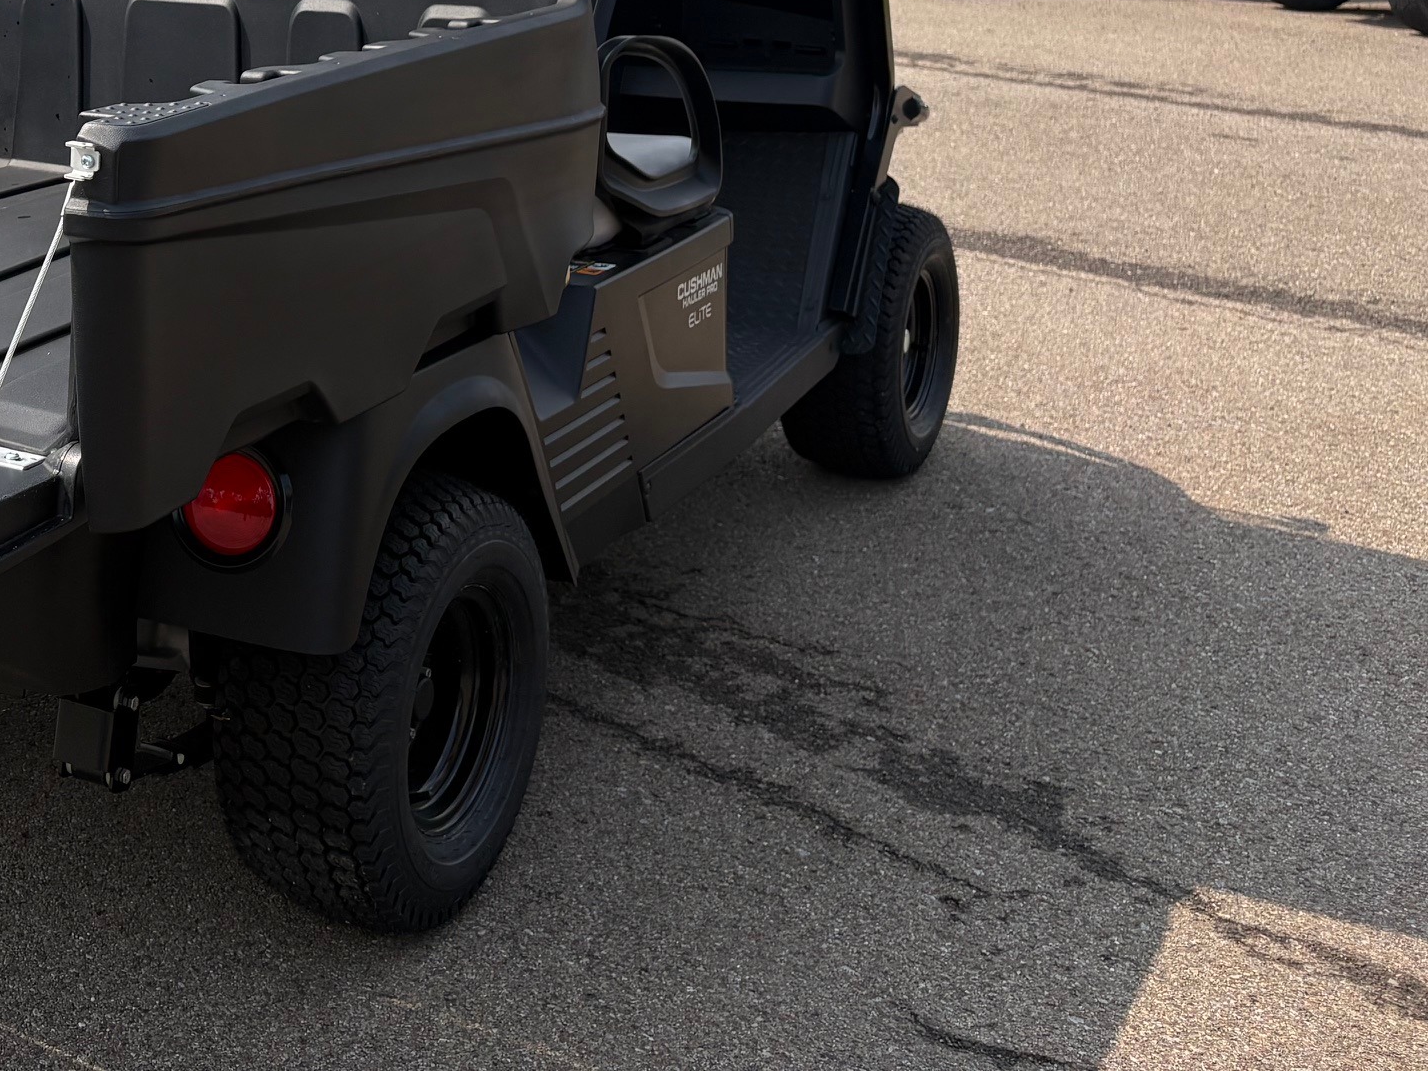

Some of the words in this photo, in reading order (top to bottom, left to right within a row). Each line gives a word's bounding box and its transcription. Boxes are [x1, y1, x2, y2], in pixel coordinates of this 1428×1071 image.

[677, 262, 723, 300] CUSHMAN
[682, 289, 706, 309] HAULER
[706, 281, 718, 297] PRO
